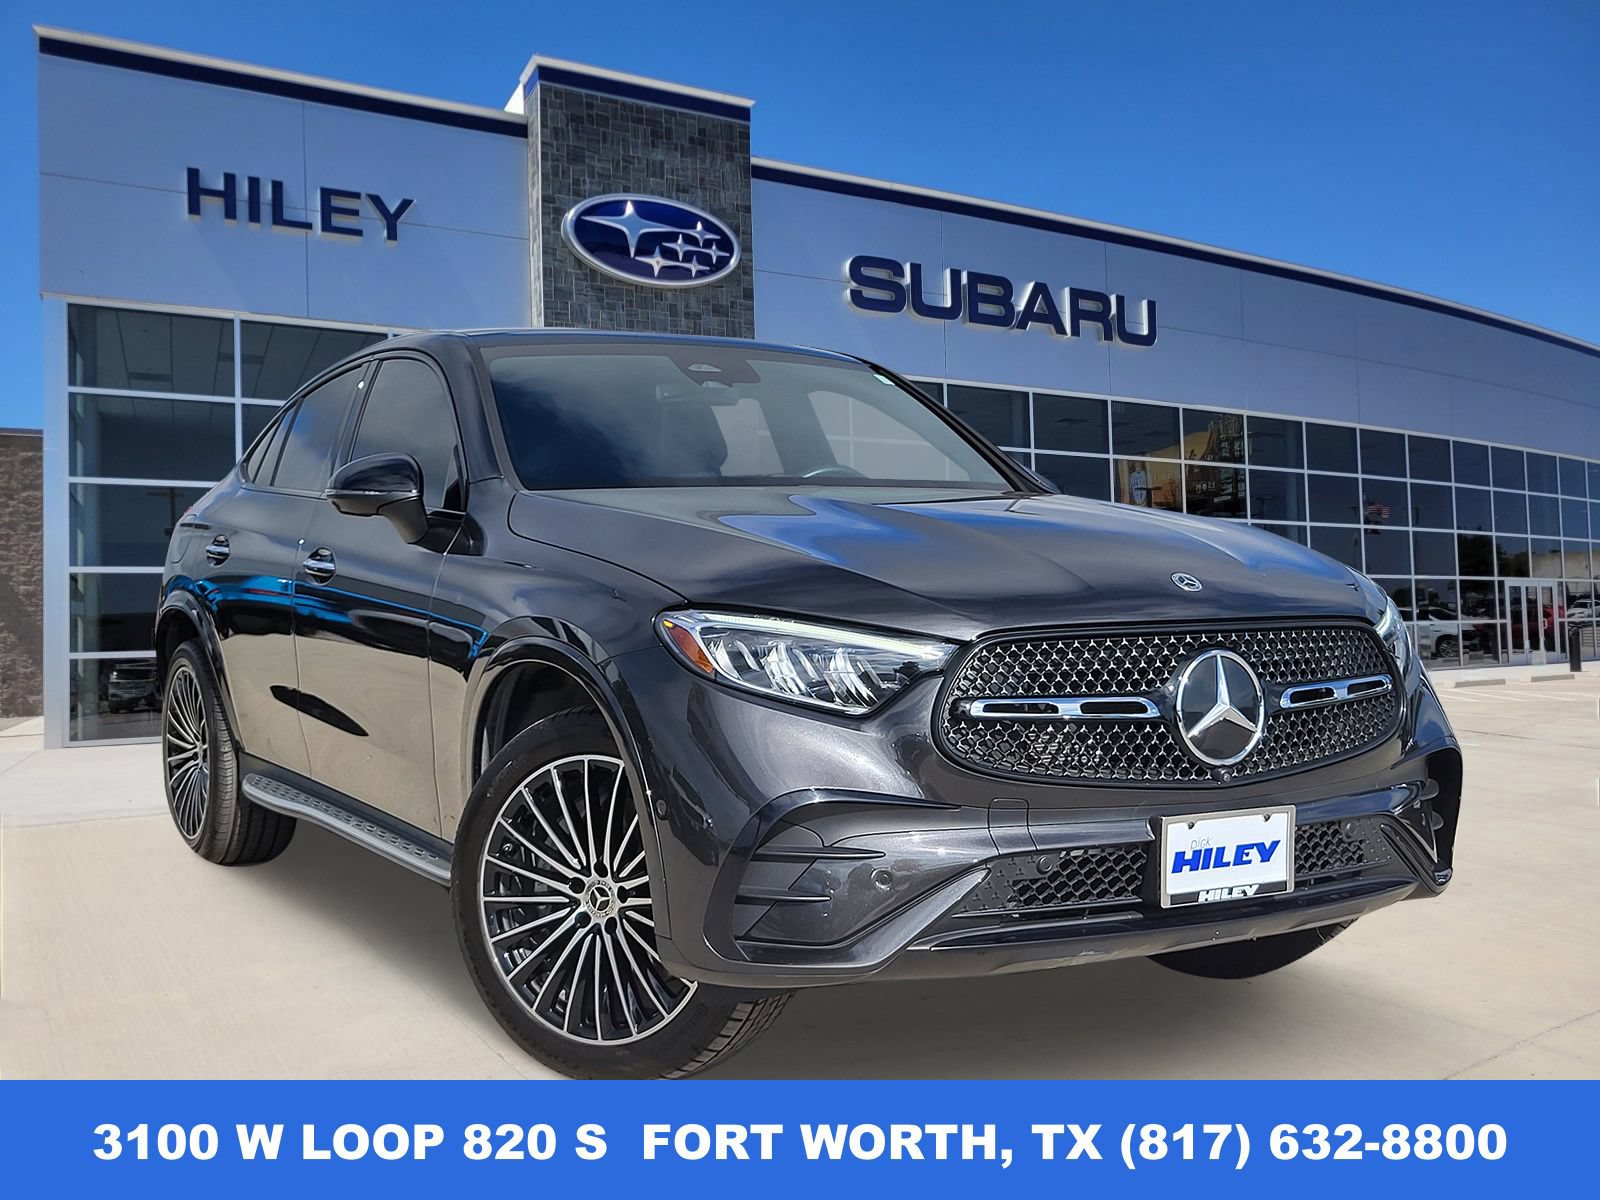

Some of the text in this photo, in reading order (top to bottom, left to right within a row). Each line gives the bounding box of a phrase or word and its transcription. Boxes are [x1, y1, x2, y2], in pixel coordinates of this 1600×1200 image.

[186, 166, 416, 243] HILEY
[845, 254, 1158, 348] SUBARU
[1171, 840, 1281, 874] HILEY
[1198, 884, 1260, 903] HILEY
